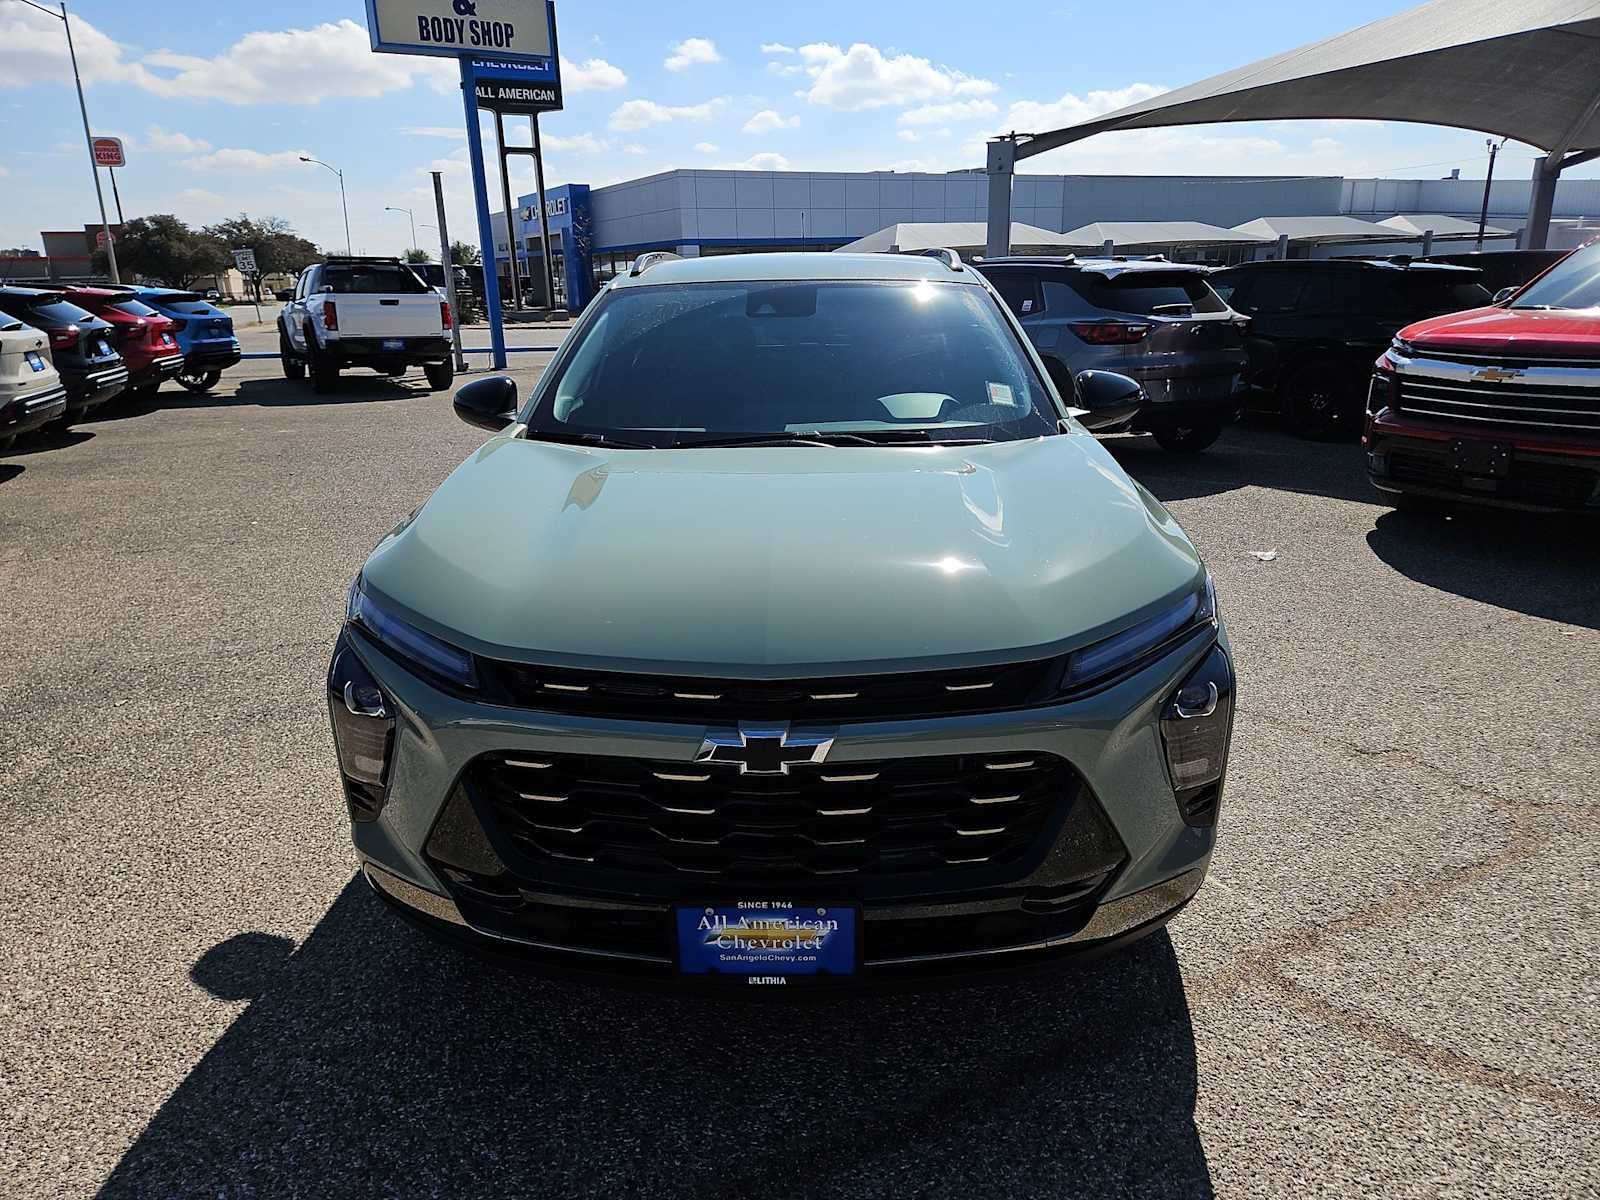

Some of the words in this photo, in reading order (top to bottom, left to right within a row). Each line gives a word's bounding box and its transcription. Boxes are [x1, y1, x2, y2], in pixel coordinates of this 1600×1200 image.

[417, 15, 465, 44] BODY
[469, 19, 514, 48] SHOP
[475, 86, 496, 98] ALL
[498, 87, 555, 101] AMERICAN
[95, 152, 121, 160] KING
[530, 198, 566, 220] CHROLET
[239, 261, 254, 270] 35
[737, 901, 769, 909] SINCE
[771, 901, 793, 909] 1946
[697, 915, 728, 930] All
[735, 915, 839, 931] American
[717, 934, 823, 950] Chevrolet
[719, 953, 817, 963] SanAngeloChevy.com
[757, 976, 787, 985] LITHIA
